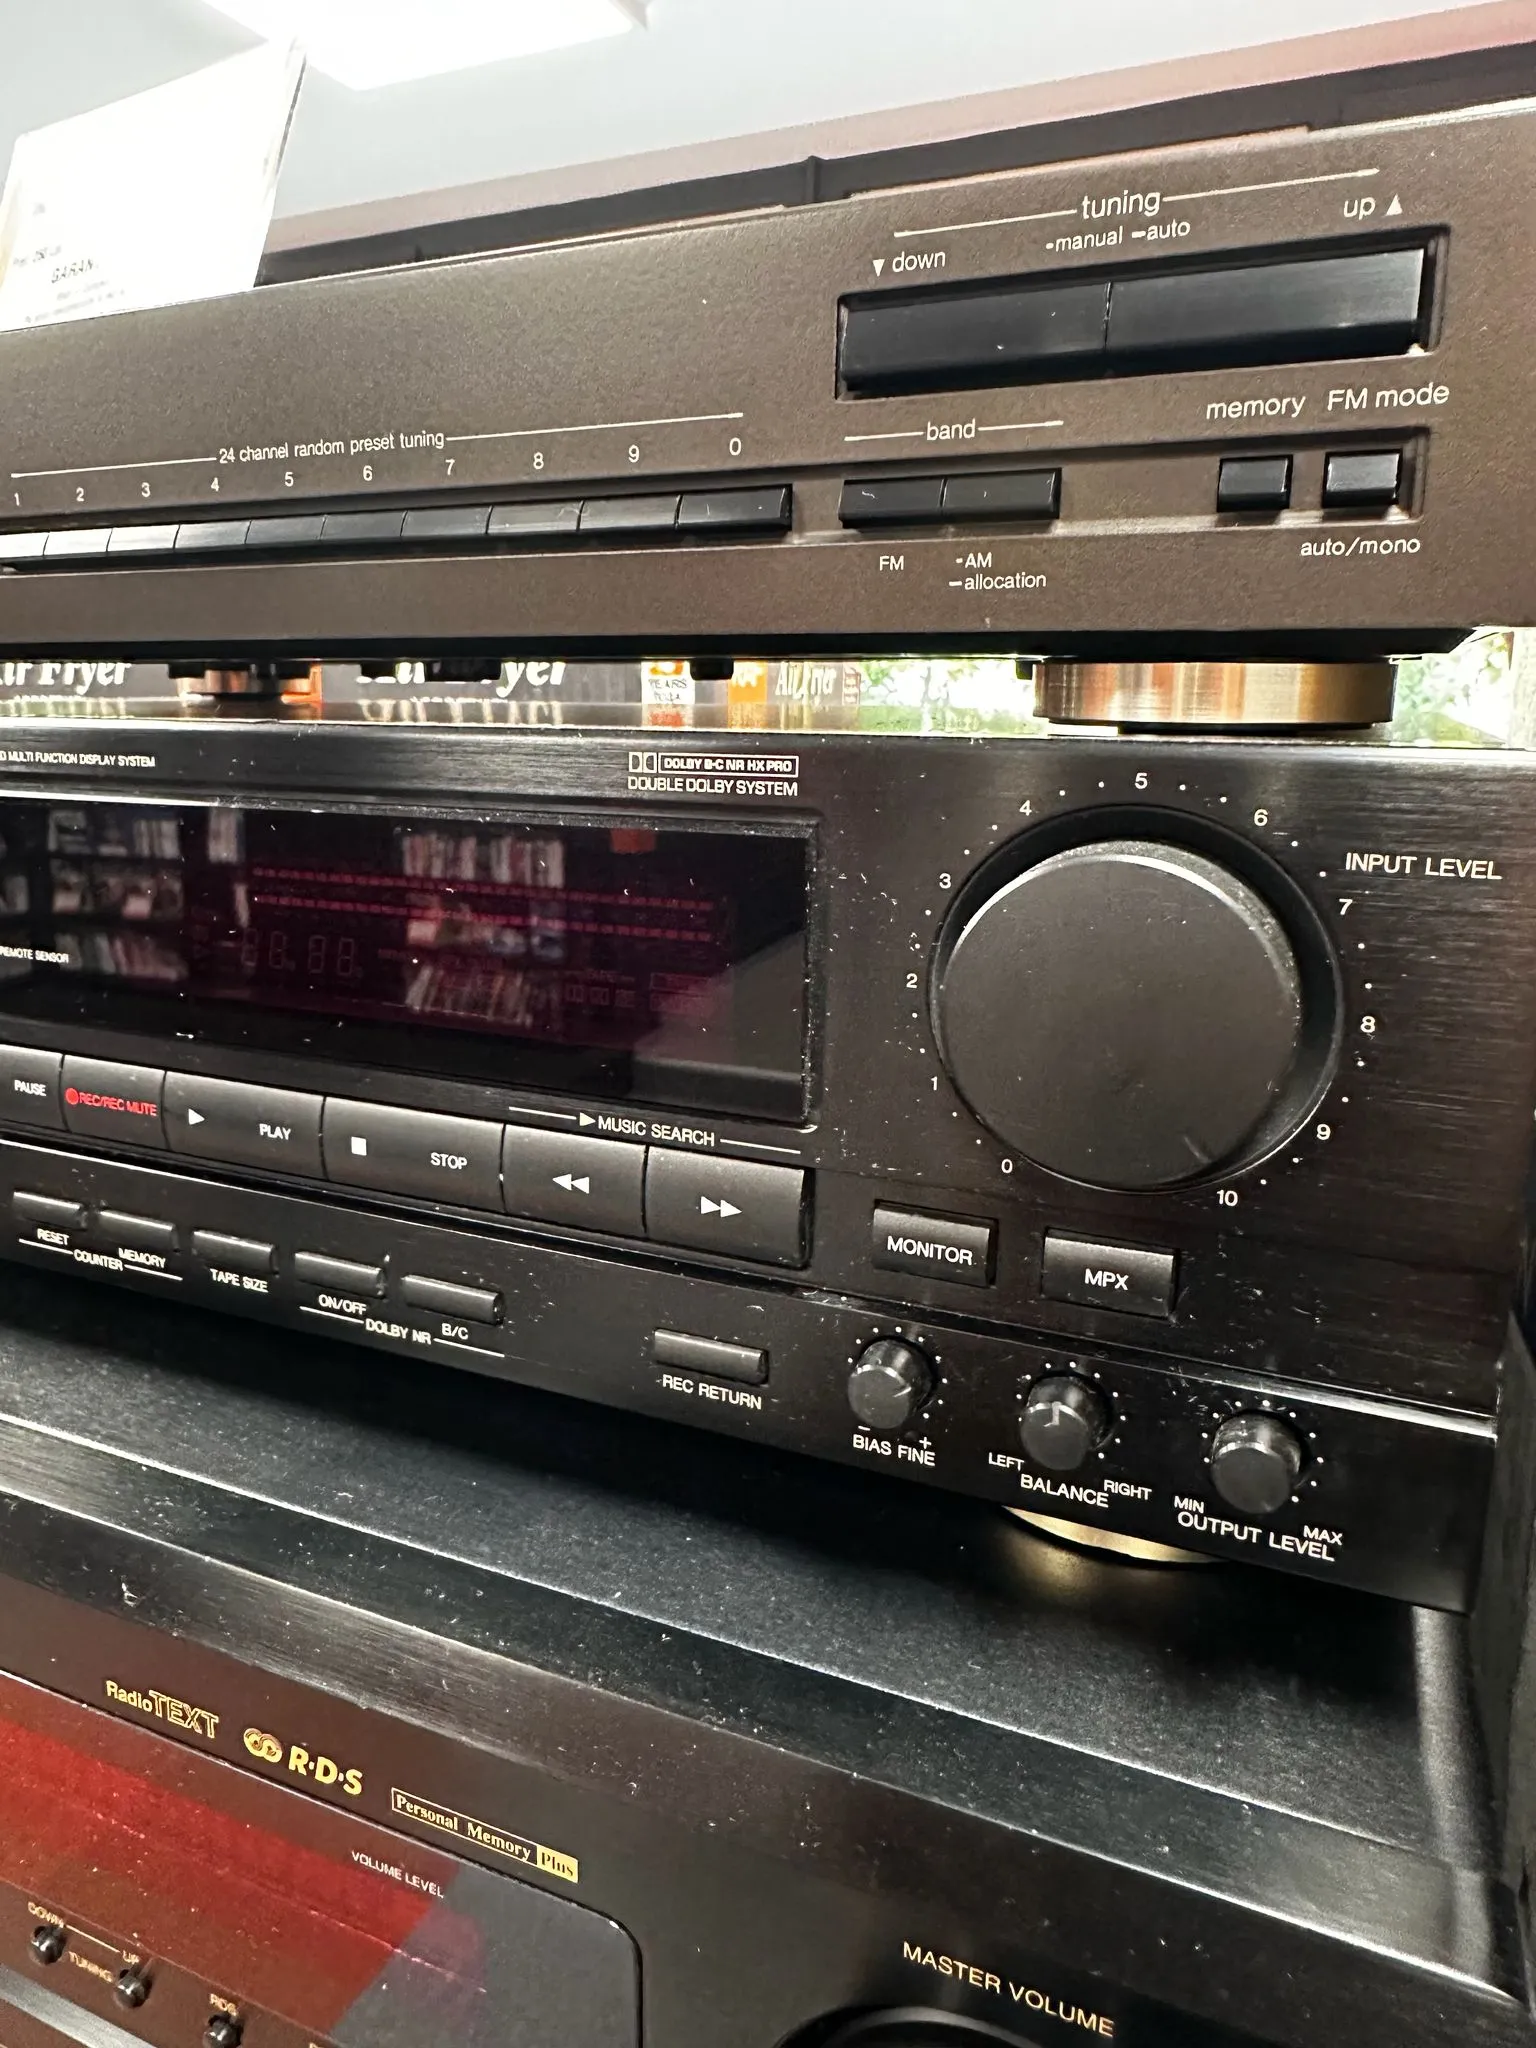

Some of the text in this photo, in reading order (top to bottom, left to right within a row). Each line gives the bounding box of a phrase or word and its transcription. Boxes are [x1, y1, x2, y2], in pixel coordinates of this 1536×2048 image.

[1081, 189, 1161, 219] tuning
[1343, 196, 1376, 220] up
[892, 251, 946, 272] down
[1327, 382, 1450, 411] FM mode
[1206, 396, 1306, 420] memory
[926, 418, 976, 441] band
[219, 431, 444, 464] 24 channel random preset tuning
[628, 444, 640, 463] 9
[729, 437, 742, 456] 0
[445, 458, 455, 476] 7
[532, 452, 545, 469] 8
[284, 471, 294, 487] 5
[362, 465, 373, 481] 6
[141, 482, 151, 497] 3
[210, 477, 220, 492] 4
[14, 493, 20, 506] 1
[76, 488, 85, 502] 2
[1300, 536, 1421, 557] auto/mono
[879, 555, 904, 571] FM
[0, 662, 33, 685] ir
[8, 751, 33, 762] MULTI
[35, 752, 78, 764] FUNCTION
[79, 753, 116, 765] DISPLAY
[118, 755, 156, 767] SYSTEM
[664, 757, 702, 770] DOLBY
[726, 760, 744, 771] NR
[747, 760, 765, 772] HX
[766, 760, 792, 772] PRO
[627, 775, 798, 797] DOUBLE DOLBY SYSTEM
[1135, 772, 1148, 790] 5
[1019, 799, 1032, 816] 4
[1253, 808, 1268, 827] 6
[1345, 852, 1503, 880] INPUT LEVEL
[939, 872, 952, 890] 3
[1338, 898, 1353, 915] 7
[0, 945, 69, 964] REMOTE SENSOR
[906, 972, 918, 989] 2
[1360, 1015, 1376, 1034] 8
[14, 1079, 47, 1097] PAUSE
[930, 1076, 938, 1091] 1
[78, 1092, 157, 1117] REC/REC MUTE
[259, 1123, 292, 1141] PLAY
[598, 1115, 716, 1148] MUSIC SEARCH
[1316, 1123, 1331, 1140] 9
[430, 1151, 468, 1171] STOP
[1001, 1158, 1013, 1174] 0
[1216, 1189, 1239, 1207] 10
[36, 1228, 69, 1246] RESET
[73, 1248, 124, 1272] COUNTER
[118, 1247, 166, 1269] MEMORY
[887, 1235, 973, 1265] MONITOR
[210, 1268, 269, 1294] TAPE SIZE
[1084, 1268, 1129, 1291] MPX
[318, 1293, 367, 1316] ON/OFF
[365, 1318, 432, 1345] DOLBY NR
[441, 1322, 469, 1340] B/C
[662, 1374, 762, 1410] REC RETURN
[852, 1434, 936, 1467] BIAS FINE
[988, 1452, 1024, 1472] LEFT
[1020, 1473, 1109, 1508] BALANCE
[1103, 1479, 1153, 1501] RIGHT
[1173, 1495, 1204, 1514] MIN
[1177, 1511, 1335, 1562] OUTPUT LEVEL
[1303, 1525, 1343, 1546] MAX
[396, 1794, 573, 1877] Personal Memory Plus
[351, 1850, 444, 1899] VOLUME LEVEL
[903, 1940, 1115, 2038] MASTER VOLUME
